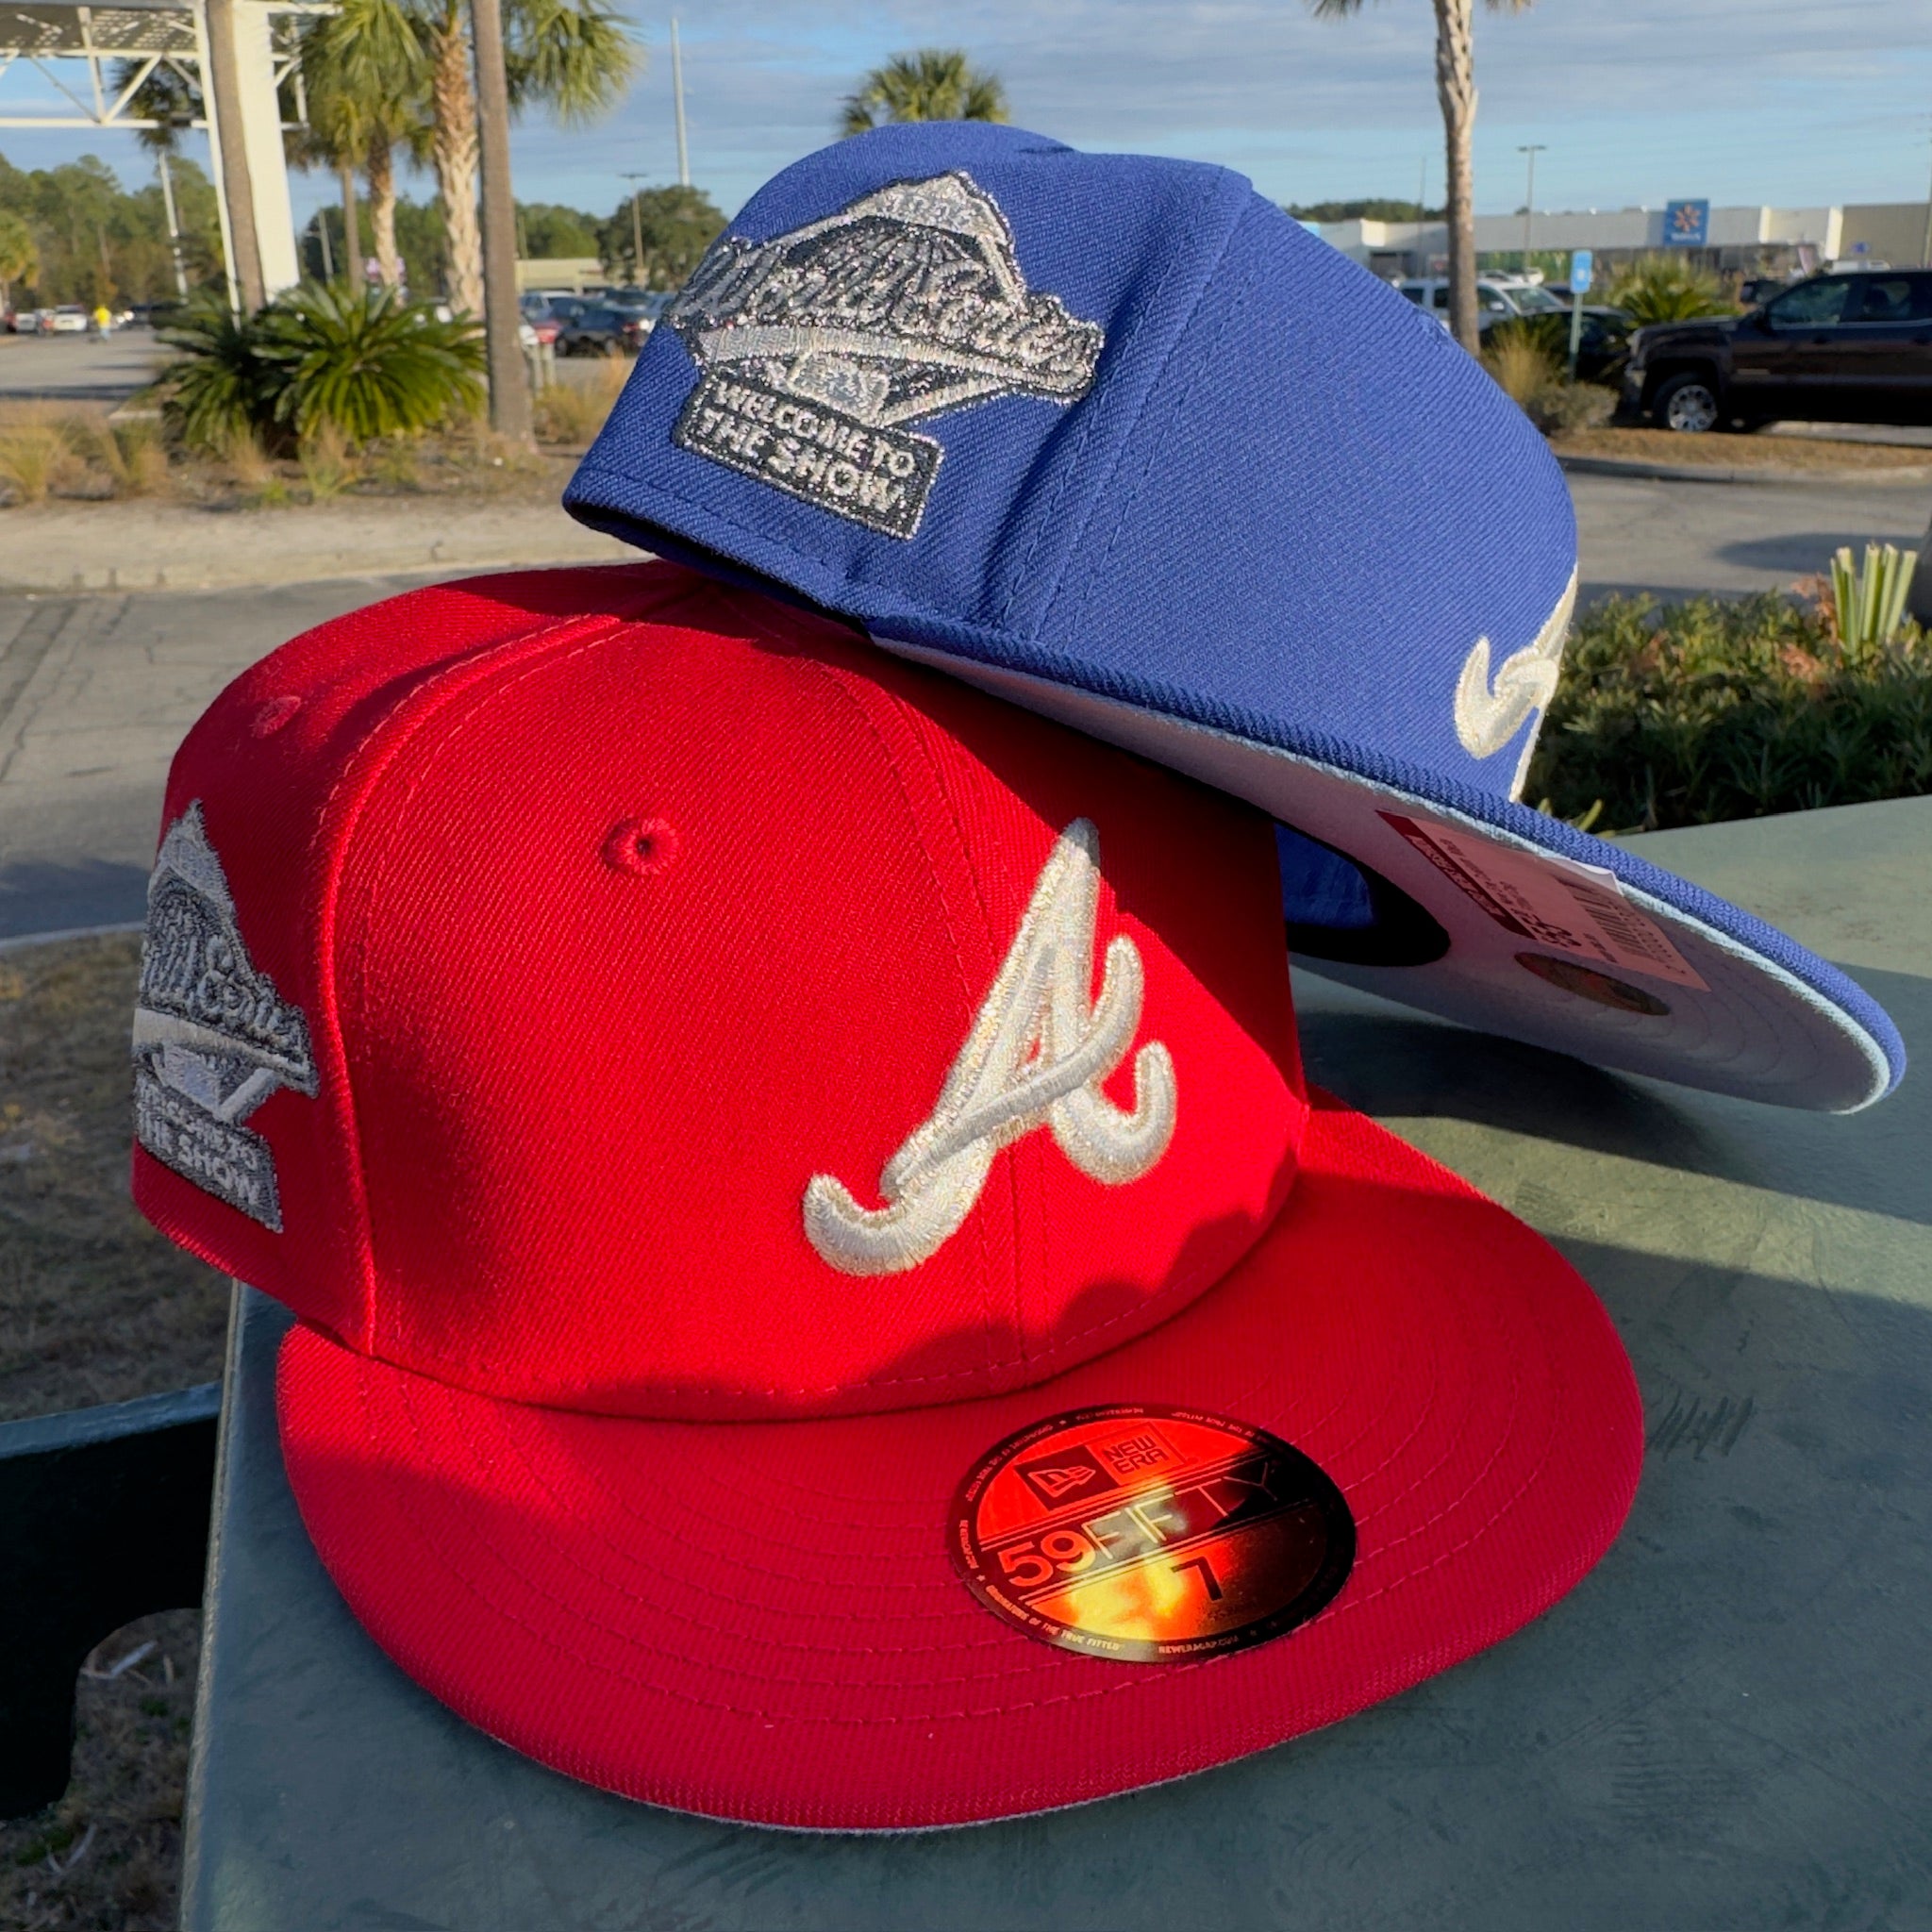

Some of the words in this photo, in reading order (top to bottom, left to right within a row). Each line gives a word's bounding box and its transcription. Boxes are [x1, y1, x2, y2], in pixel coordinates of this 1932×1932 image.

[698, 406, 769, 460] THE
[766, 438, 908, 515] SHOW
[714, 379, 870, 462] WELCOME
[870, 438, 917, 477] TO
[803, 817, 1177, 1275] A
[1102, 1435, 1157, 1462] NEW
[1113, 1448, 1170, 1474] ERA
[998, 1461, 1278, 1587] 59FIFTY
[1171, 1556, 1224, 1602] 7
